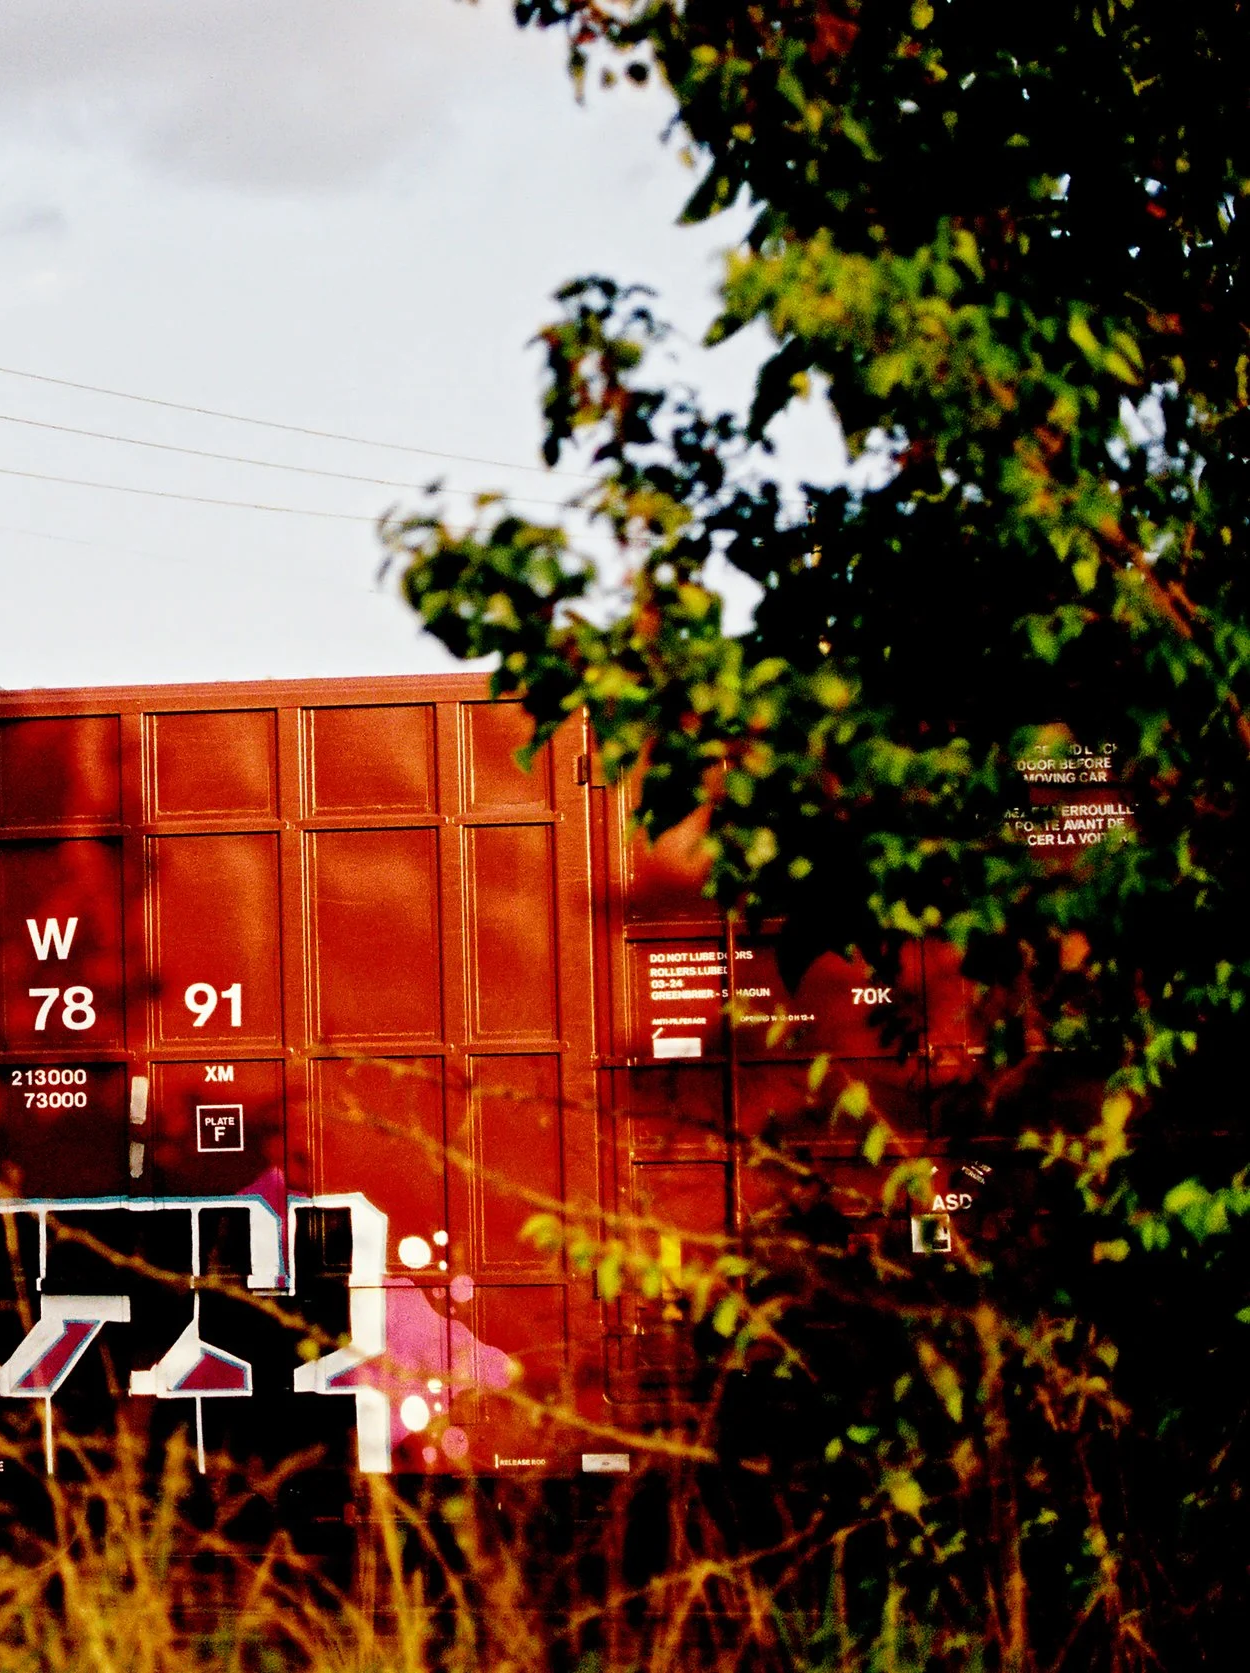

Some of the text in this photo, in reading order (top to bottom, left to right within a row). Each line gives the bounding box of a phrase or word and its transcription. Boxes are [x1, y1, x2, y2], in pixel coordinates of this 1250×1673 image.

[1060, 757, 1112, 770] BEFORE
[1079, 771, 1107, 782] CAR
[1015, 821, 1060, 832] POTE
[1063, 818, 1105, 831] AVANT
[1057, 833, 1076, 845] LA
[26, 917, 79, 961] W
[650, 951, 754, 963] DO NOT LUBE DRS
[650, 967, 696, 977] ROLLERS
[651, 979, 684, 989] 03-24
[651, 989, 715, 1000] GREENBRIER
[721, 988, 771, 998] SHAGUN
[851, 988, 892, 1005] 70K
[28, 986, 96, 1031] 78
[184, 983, 243, 1028] 91
[11, 1069, 87, 1087] 213000
[204, 1065, 235, 1082] XM
[24, 1092, 87, 1109] 73000
[204, 1117, 235, 1127] PLATE
[214, 1126, 226, 1141] F
[931, 1193, 973, 1211] ASD
[500, 1458, 531, 1466] RELEASE
